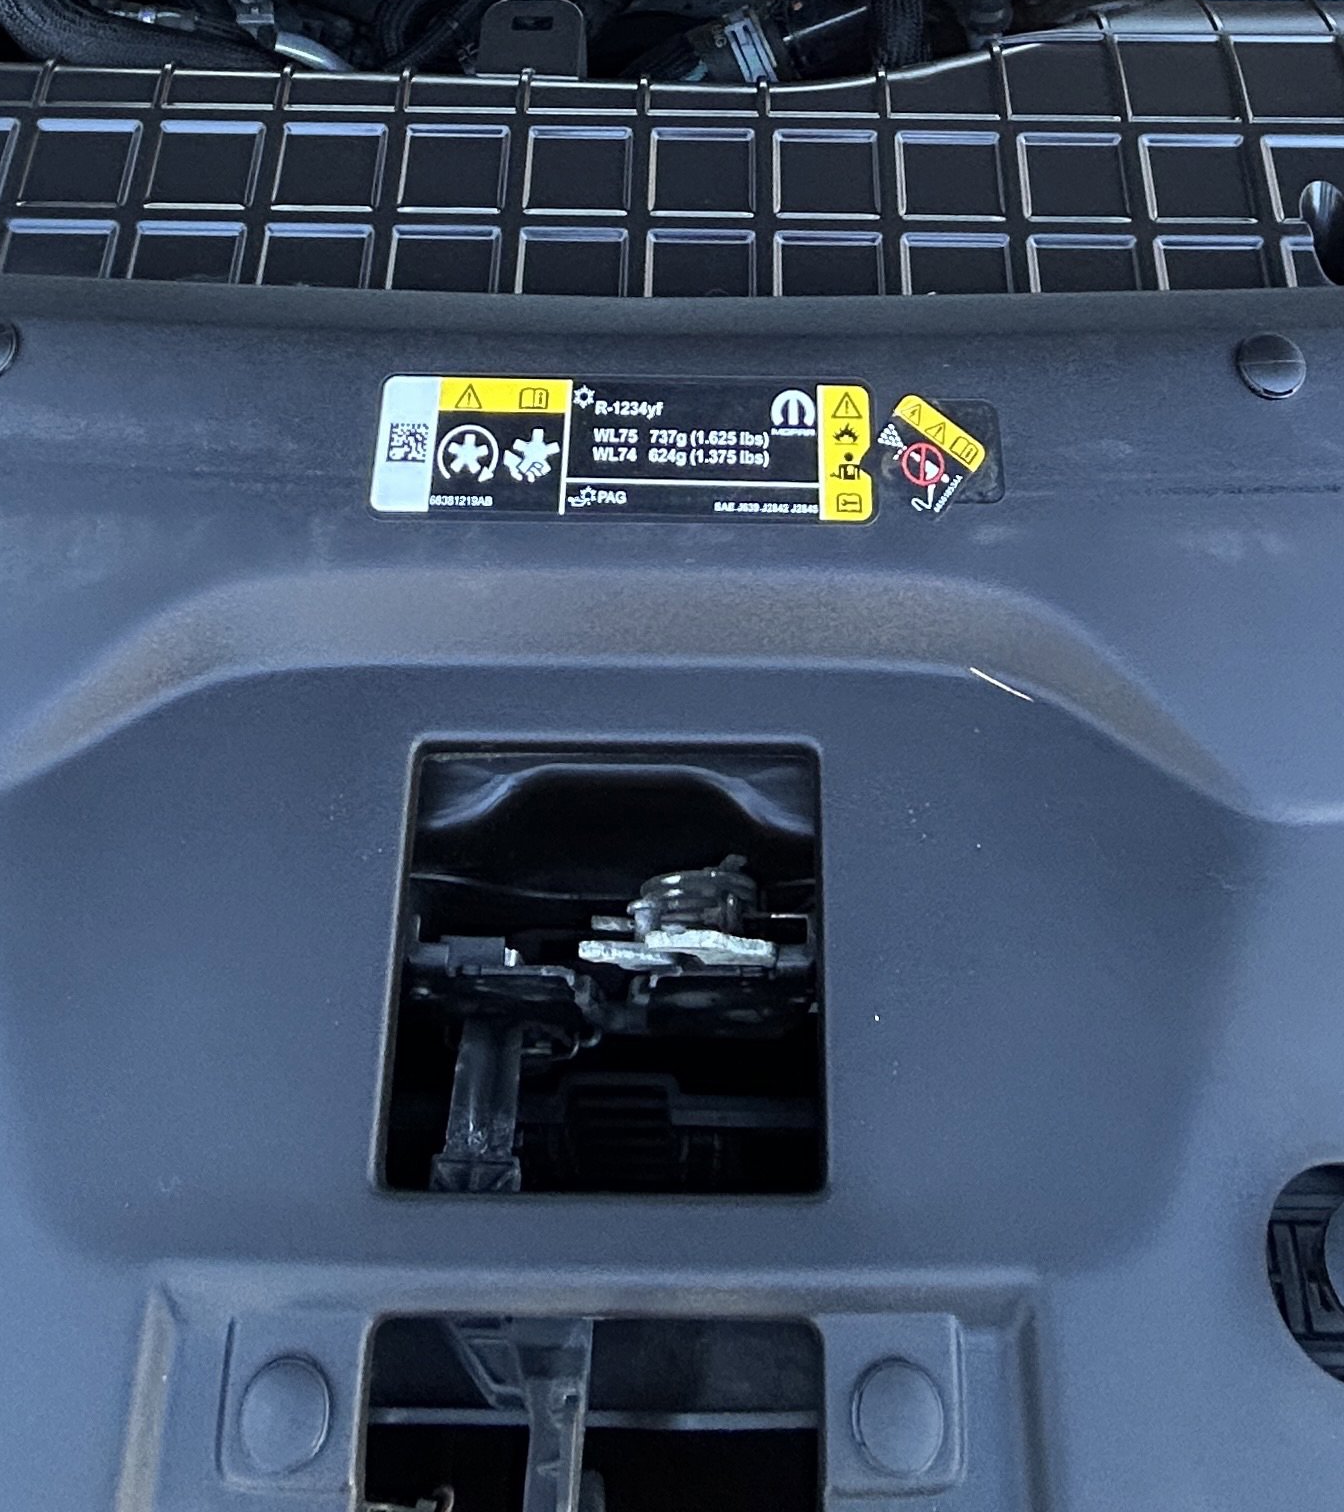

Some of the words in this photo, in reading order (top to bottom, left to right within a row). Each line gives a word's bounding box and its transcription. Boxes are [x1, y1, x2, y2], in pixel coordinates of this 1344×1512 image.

[594, 400, 664, 420] R-1234yf
[593, 428, 639, 444] WL75
[649, 429, 687, 447] 737g
[689, 430, 738, 448] (1.625
[740, 431, 770, 449] lbs)
[592, 447, 638, 463] WL74
[648, 448, 687, 466] 624g
[689, 449, 738, 467] (1.375
[740, 450, 770, 468] lbs)
[596, 491, 627, 505] PAG
